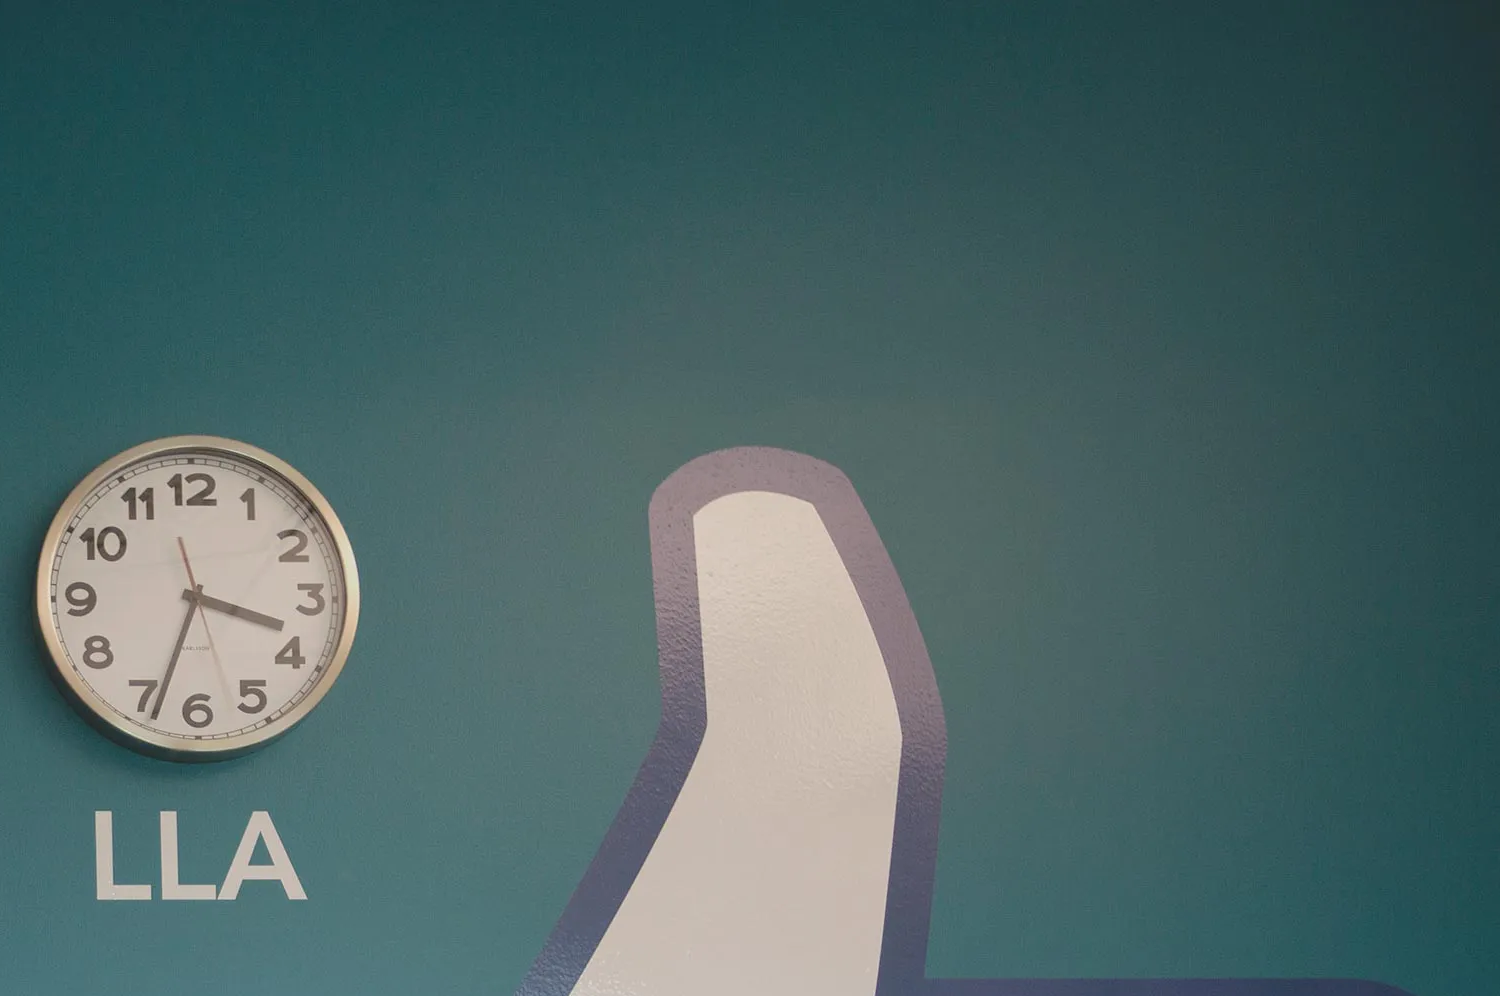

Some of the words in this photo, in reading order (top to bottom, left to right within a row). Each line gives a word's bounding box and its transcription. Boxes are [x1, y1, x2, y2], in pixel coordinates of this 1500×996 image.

[120, 487, 155, 521] 11
[166, 472, 217, 507] 12
[239, 487, 256, 521] 1
[78, 526, 127, 562] 10
[276, 528, 310, 563] 2
[64, 581, 97, 617] 9
[295, 582, 326, 617] 3
[82, 635, 114, 670] 8
[274, 635, 306, 670] 4
[128, 679, 158, 715] 7
[181, 693, 214, 729] 6
[236, 679, 268, 715] 5
[94, 810, 309, 901] LLA
